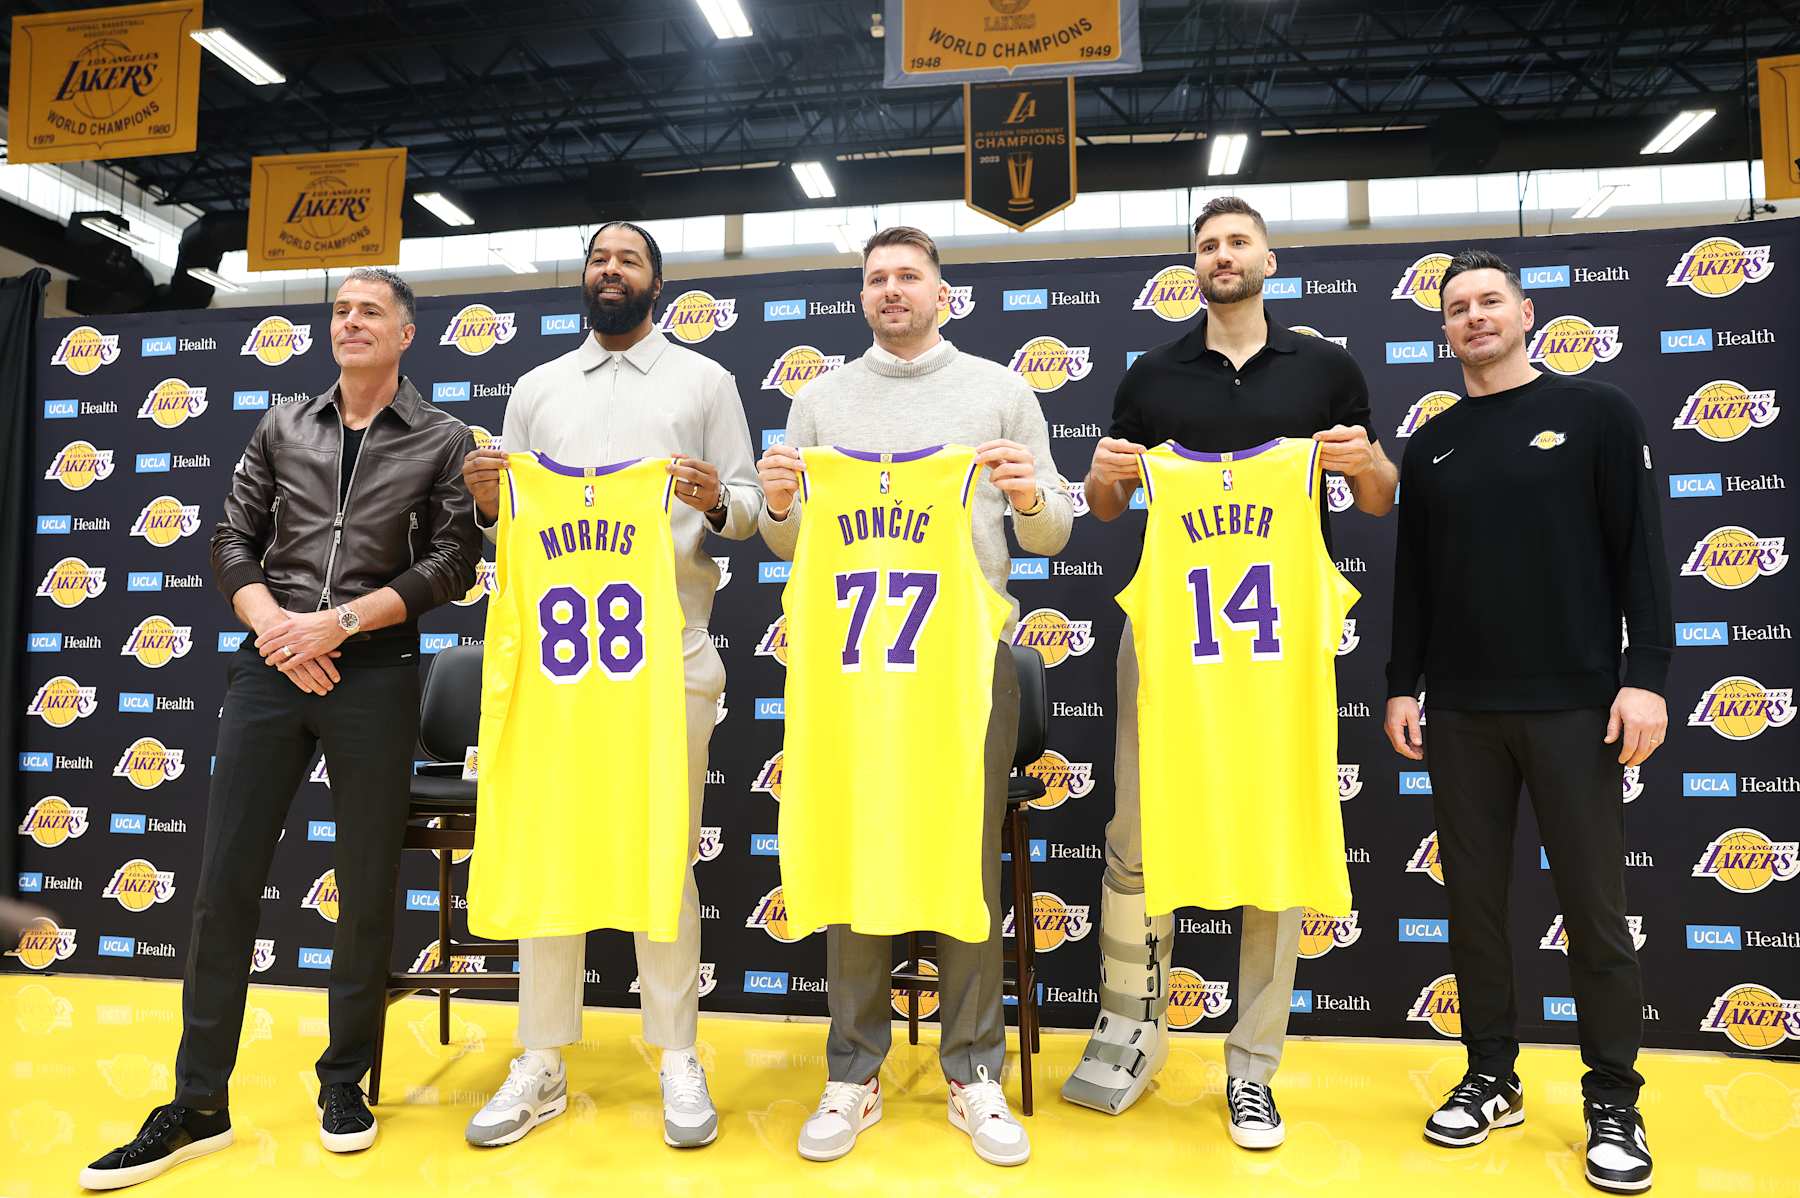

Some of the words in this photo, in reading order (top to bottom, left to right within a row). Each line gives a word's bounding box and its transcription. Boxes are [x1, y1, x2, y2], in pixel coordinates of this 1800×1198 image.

[928, 26, 986, 58] WORLD
[992, 17, 1093, 58] CHAMPIONS
[87, 57, 106, 66] LOS
[108, 52, 159, 65] ANGELES
[1079, 45, 1112, 58] 1949
[911, 57, 941, 69] 1948
[51, 60, 157, 101] LAKERS
[47, 109, 86, 135] WORLD
[90, 101, 159, 135] CHAMPIONS
[33, 134, 55, 145] 1979
[975, 134, 1065, 149] CHAMPIONS
[284, 192, 370, 224] LAKERS
[280, 230, 311, 250] WORLD
[314, 225, 370, 251] CHAMPIONS
[268, 248, 285, 256] 1971
[1527, 271, 1564, 284] UCLA
[1574, 266, 1630, 283] Health
[1676, 255, 1764, 282] LAKERS
[1143, 281, 1208, 306] LAKER
[1263, 281, 1297, 295] UCLA
[1305, 280, 1357, 295] Health
[1009, 294, 1042, 306] UCLA
[1052, 290, 1100, 306] Health
[663, 305, 730, 328] LAKERS
[769, 304, 801, 317] UCLA
[809, 301, 856, 315] Health
[447, 319, 509, 341] LAKERS
[546, 319, 576, 331] UCLA
[146, 342, 172, 352] UCLA
[179, 338, 217, 352] Health
[247, 330, 306, 351] LAKERS
[1531, 332, 1612, 358] LAKERS
[1668, 335, 1706, 348] UCLA
[1717, 329, 1776, 347] Health
[57, 340, 114, 361] LAKERS
[1392, 346, 1428, 359] UCLA
[1013, 350, 1085, 377] LAKERS
[437, 387, 466, 398] UCLA
[473, 383, 513, 398] Health
[49, 403, 74, 414] UCLA
[81, 401, 118, 415] Health
[144, 392, 202, 414] LAKERS
[238, 395, 265, 406] UCLA
[1683, 398, 1769, 425] LAKERS
[1052, 424, 1102, 438] Health
[51, 454, 108, 476] LAKERS
[140, 458, 166, 469] UCLA
[173, 455, 211, 468] Health
[1677, 479, 1716, 492] UCLA
[1726, 474, 1786, 492] Health
[42, 519, 67, 530] UCLA
[74, 517, 110, 531] Health
[136, 510, 194, 532] LAKERS
[837, 499, 933, 546] DONČIĆ
[1181, 503, 1273, 544] KLEBER
[539, 519, 636, 560] MORRIS
[1335, 557, 1367, 572] alth
[1690, 544, 1778, 571] LAKERS
[764, 567, 791, 578] UCL
[1010, 563, 1044, 575] UCLA
[1053, 561, 1103, 576] Health
[43, 571, 100, 594] LAKERS
[132, 576, 158, 587] UCLA
[165, 575, 203, 588] Health
[834, 570, 939, 669] 77
[1187, 564, 1282, 661] 14
[538, 582, 645, 681] 88
[1012, 623, 1086, 652] LAKERS
[1682, 627, 1722, 641] UCLA
[1732, 624, 1792, 641] Health
[32, 637, 57, 648] UCLA
[64, 636, 101, 649] Health
[128, 629, 186, 654] LAKERS
[425, 638, 453, 649] UCLA
[33, 689, 91, 714] LAKERS
[123, 697, 150, 708] UCLA
[156, 696, 195, 711] Health
[760, 703, 784, 715] UCL
[1052, 702, 1103, 717] Health
[1698, 693, 1786, 722] LAKERS
[1338, 703, 1370, 717] alth
[23, 757, 48, 767] UCLA
[56, 755, 93, 770] Health
[120, 750, 178, 776] LAKERS
[1406, 777, 1432, 789] UCL
[1690, 778, 1730, 791] UCLA
[1741, 776, 1800, 793] Health
[24, 809, 82, 834] LAKERS
[115, 818, 141, 829] UCLA
[149, 818, 187, 833] Health
[313, 825, 336, 837] UCL
[756, 839, 779, 851] UCL
[1050, 844, 1101, 860] Health
[1702, 844, 1792, 876] LAKERS
[19, 877, 38, 888] CLA
[44, 876, 83, 890] Health
[109, 872, 169, 899] LAKERS
[412, 894, 440, 906] UCLA
[1179, 918, 1232, 935] Health
[1300, 919, 1353, 942] KERS
[1405, 924, 1442, 937] UCLA
[1694, 931, 1735, 945] UCLA
[103, 941, 130, 952] UCLA
[137, 941, 176, 957] Health
[303, 952, 331, 964] UCLA
[750, 976, 782, 988] UCLA
[791, 976, 828, 993] Healt
[1047, 988, 1098, 1004] Health
[1168, 989, 1222, 1012] KERS
[1316, 994, 1371, 1011] Health
[1551, 1002, 1576, 1015] UCL
[1758, 1001, 1800, 1009] ANGELE
